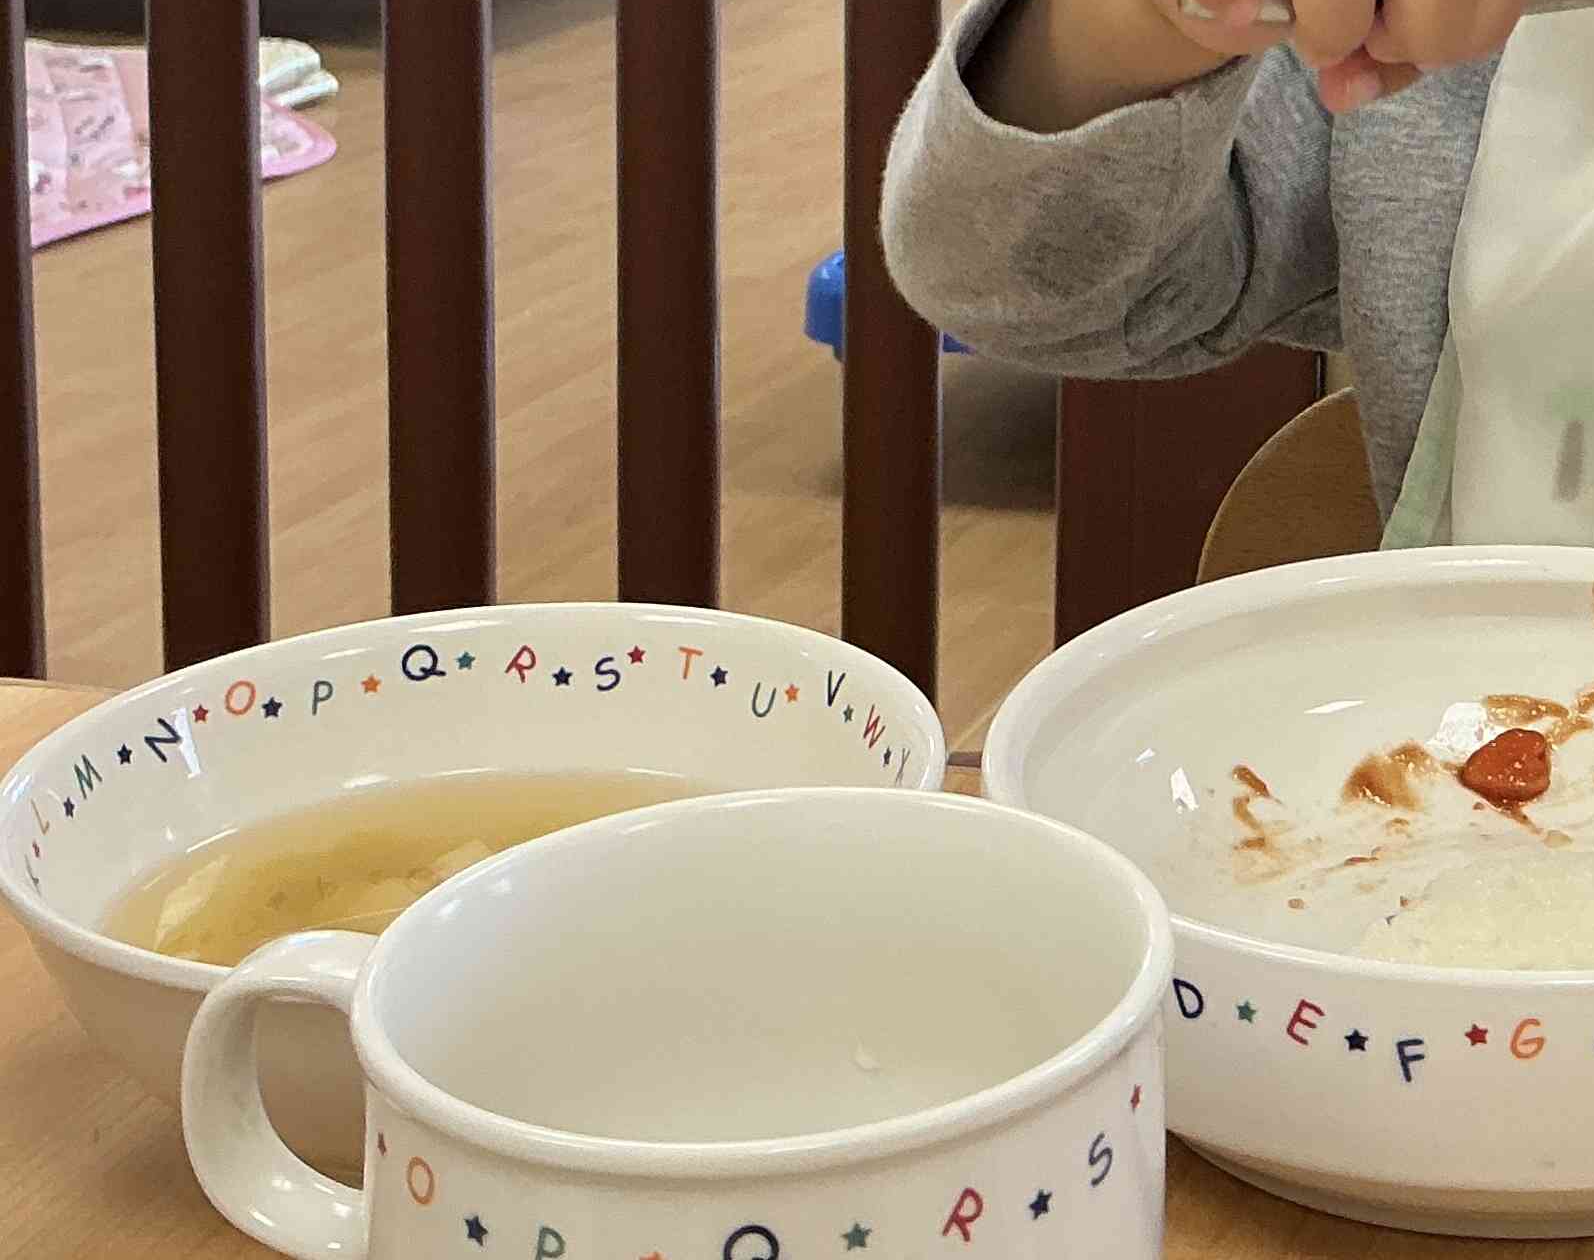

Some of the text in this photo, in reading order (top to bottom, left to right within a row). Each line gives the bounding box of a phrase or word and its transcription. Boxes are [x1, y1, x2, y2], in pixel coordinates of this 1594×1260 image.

[73, 753, 103, 800] M
[224, 680, 257, 716] O
[311, 680, 334, 716] P
[401, 643, 447, 681] Q
[504, 644, 537, 683] R
[594, 656, 621, 691] S
[678, 646, 704, 680] T
[751, 682, 777, 718] U
[827, 669, 846, 707] V
[863, 704, 886, 749] W
[1172, 977, 1205, 1019] D
[1286, 998, 1326, 1046] E
[1396, 1038, 1425, 1083] F
[1509, 1018, 1546, 1059] G
[405, 1156, 434, 1205] O
[942, 1187, 984, 1243] R
[1088, 1133, 1113, 1188] S
